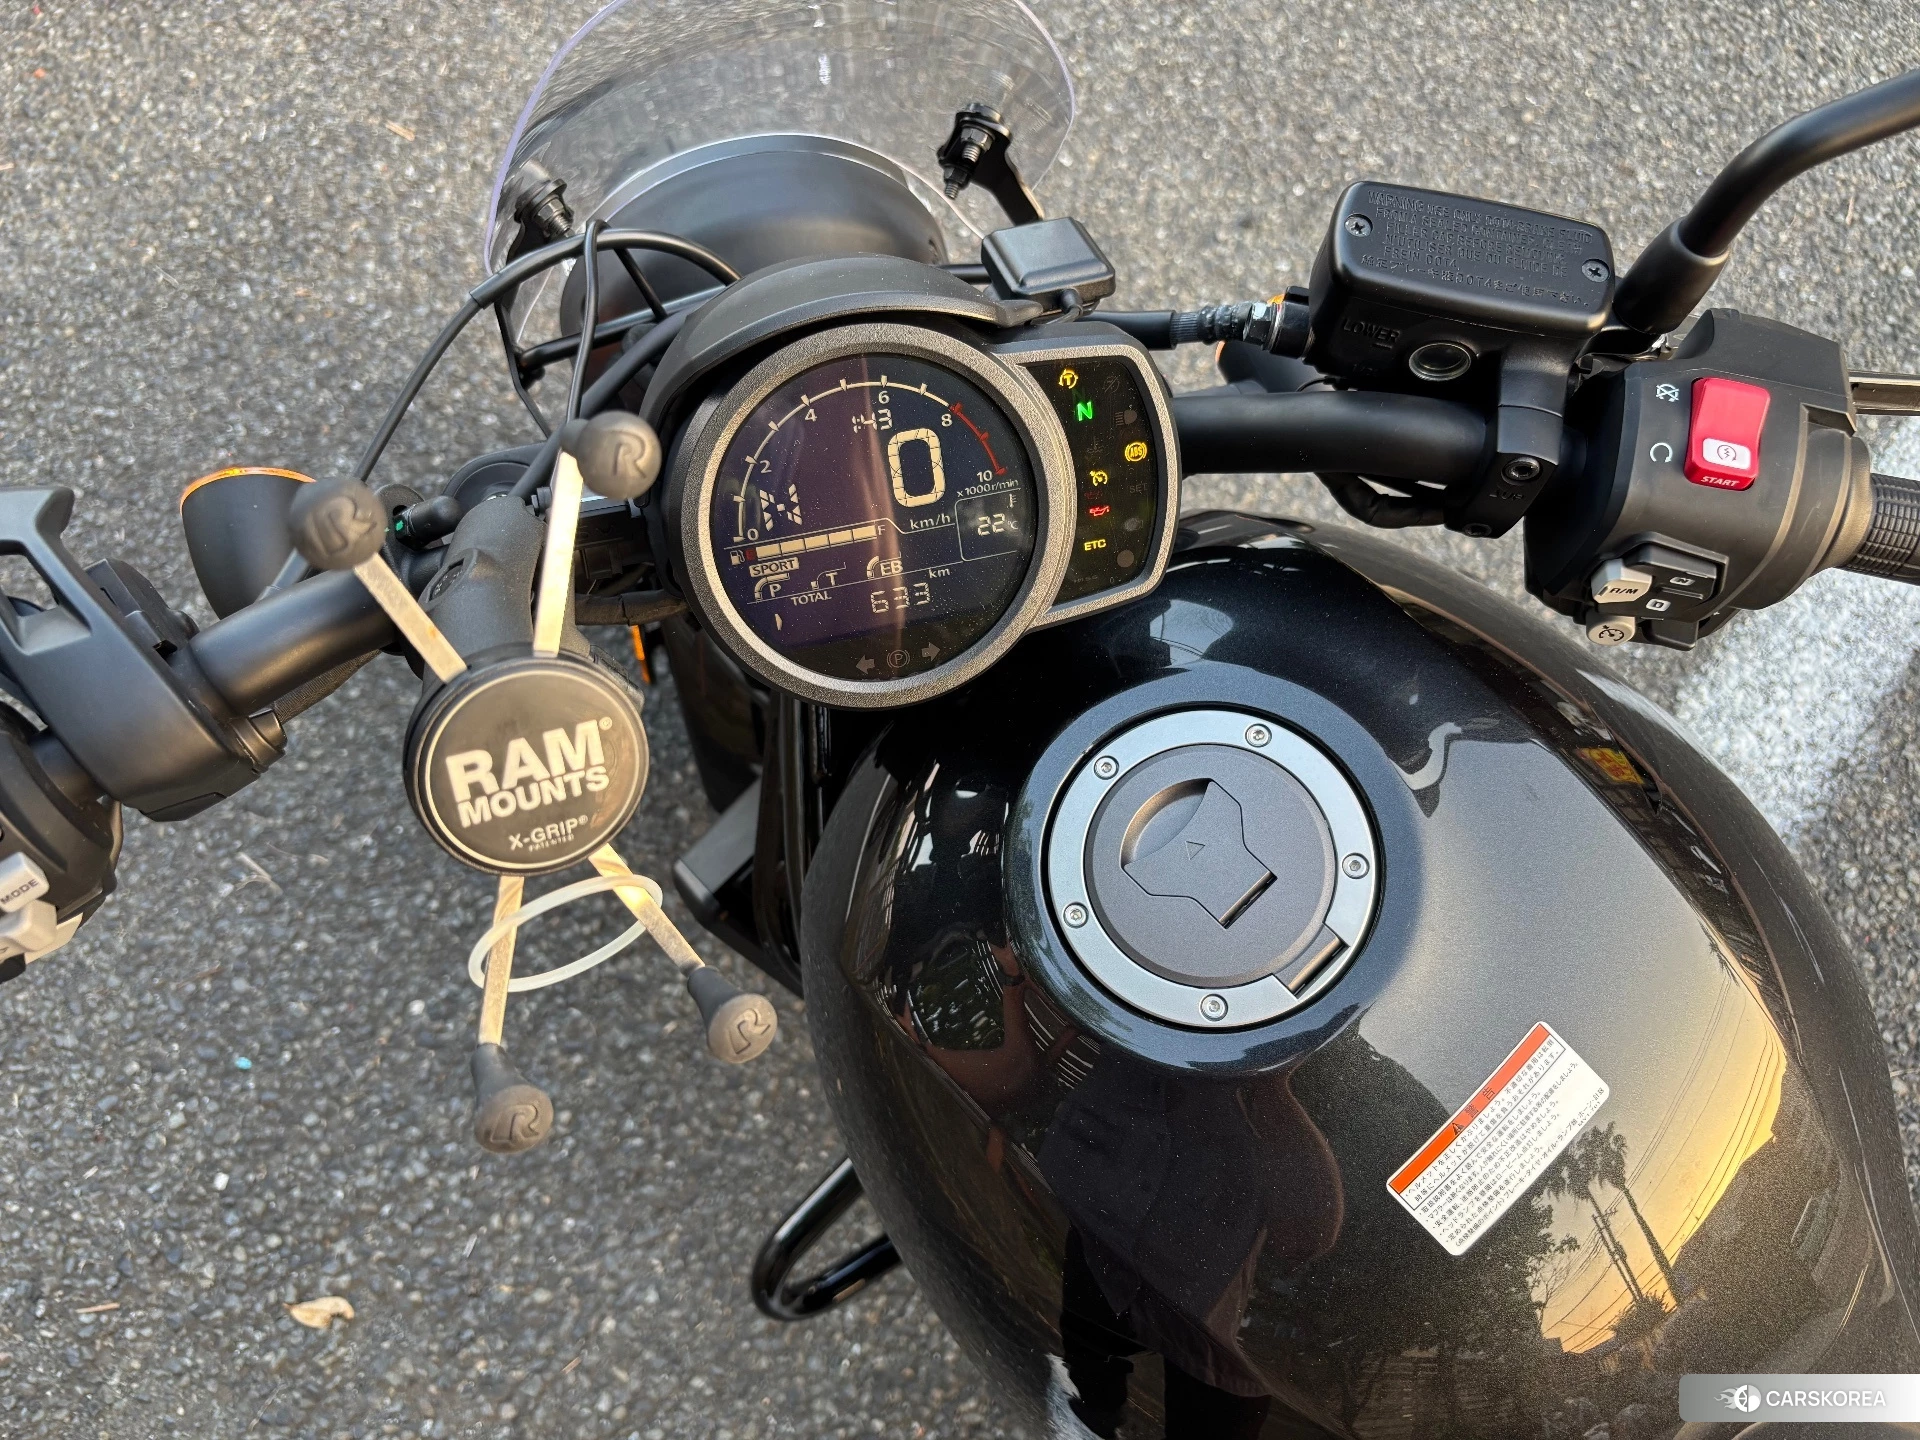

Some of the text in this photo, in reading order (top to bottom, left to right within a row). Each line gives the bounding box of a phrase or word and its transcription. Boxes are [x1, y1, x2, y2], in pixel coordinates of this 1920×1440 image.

[1366, 189, 1425, 213] WARNING
[1374, 205, 1408, 223] FROM
[1420, 214, 1468, 234] SEALED
[1385, 220, 1428, 240] FILLER
[1343, 318, 1402, 343] LOWER
[878, 390, 891, 405] 6
[804, 409, 817, 422] 4
[1076, 401, 1093, 421] N
[941, 414, 953, 427] 8
[760, 460, 772, 474] 2
[887, 428, 946, 507] 0
[976, 470, 993, 482] 10
[1700, 475, 1740, 488] START
[1129, 483, 1147, 494] SET
[910, 513, 951, 529] km/h
[978, 513, 1005, 536] 22
[747, 528, 759, 541] 0
[877, 524, 886, 536] F
[1084, 539, 1107, 551] ETC
[752, 559, 795, 576] SPORT
[880, 560, 903, 577] EB
[826, 572, 839, 586] T
[769, 583, 782, 598] P
[791, 566, 951, 614] TOTAL 633 km
[457, 765, 610, 829] MOUNTS
[1, 878, 39, 904] MODE
